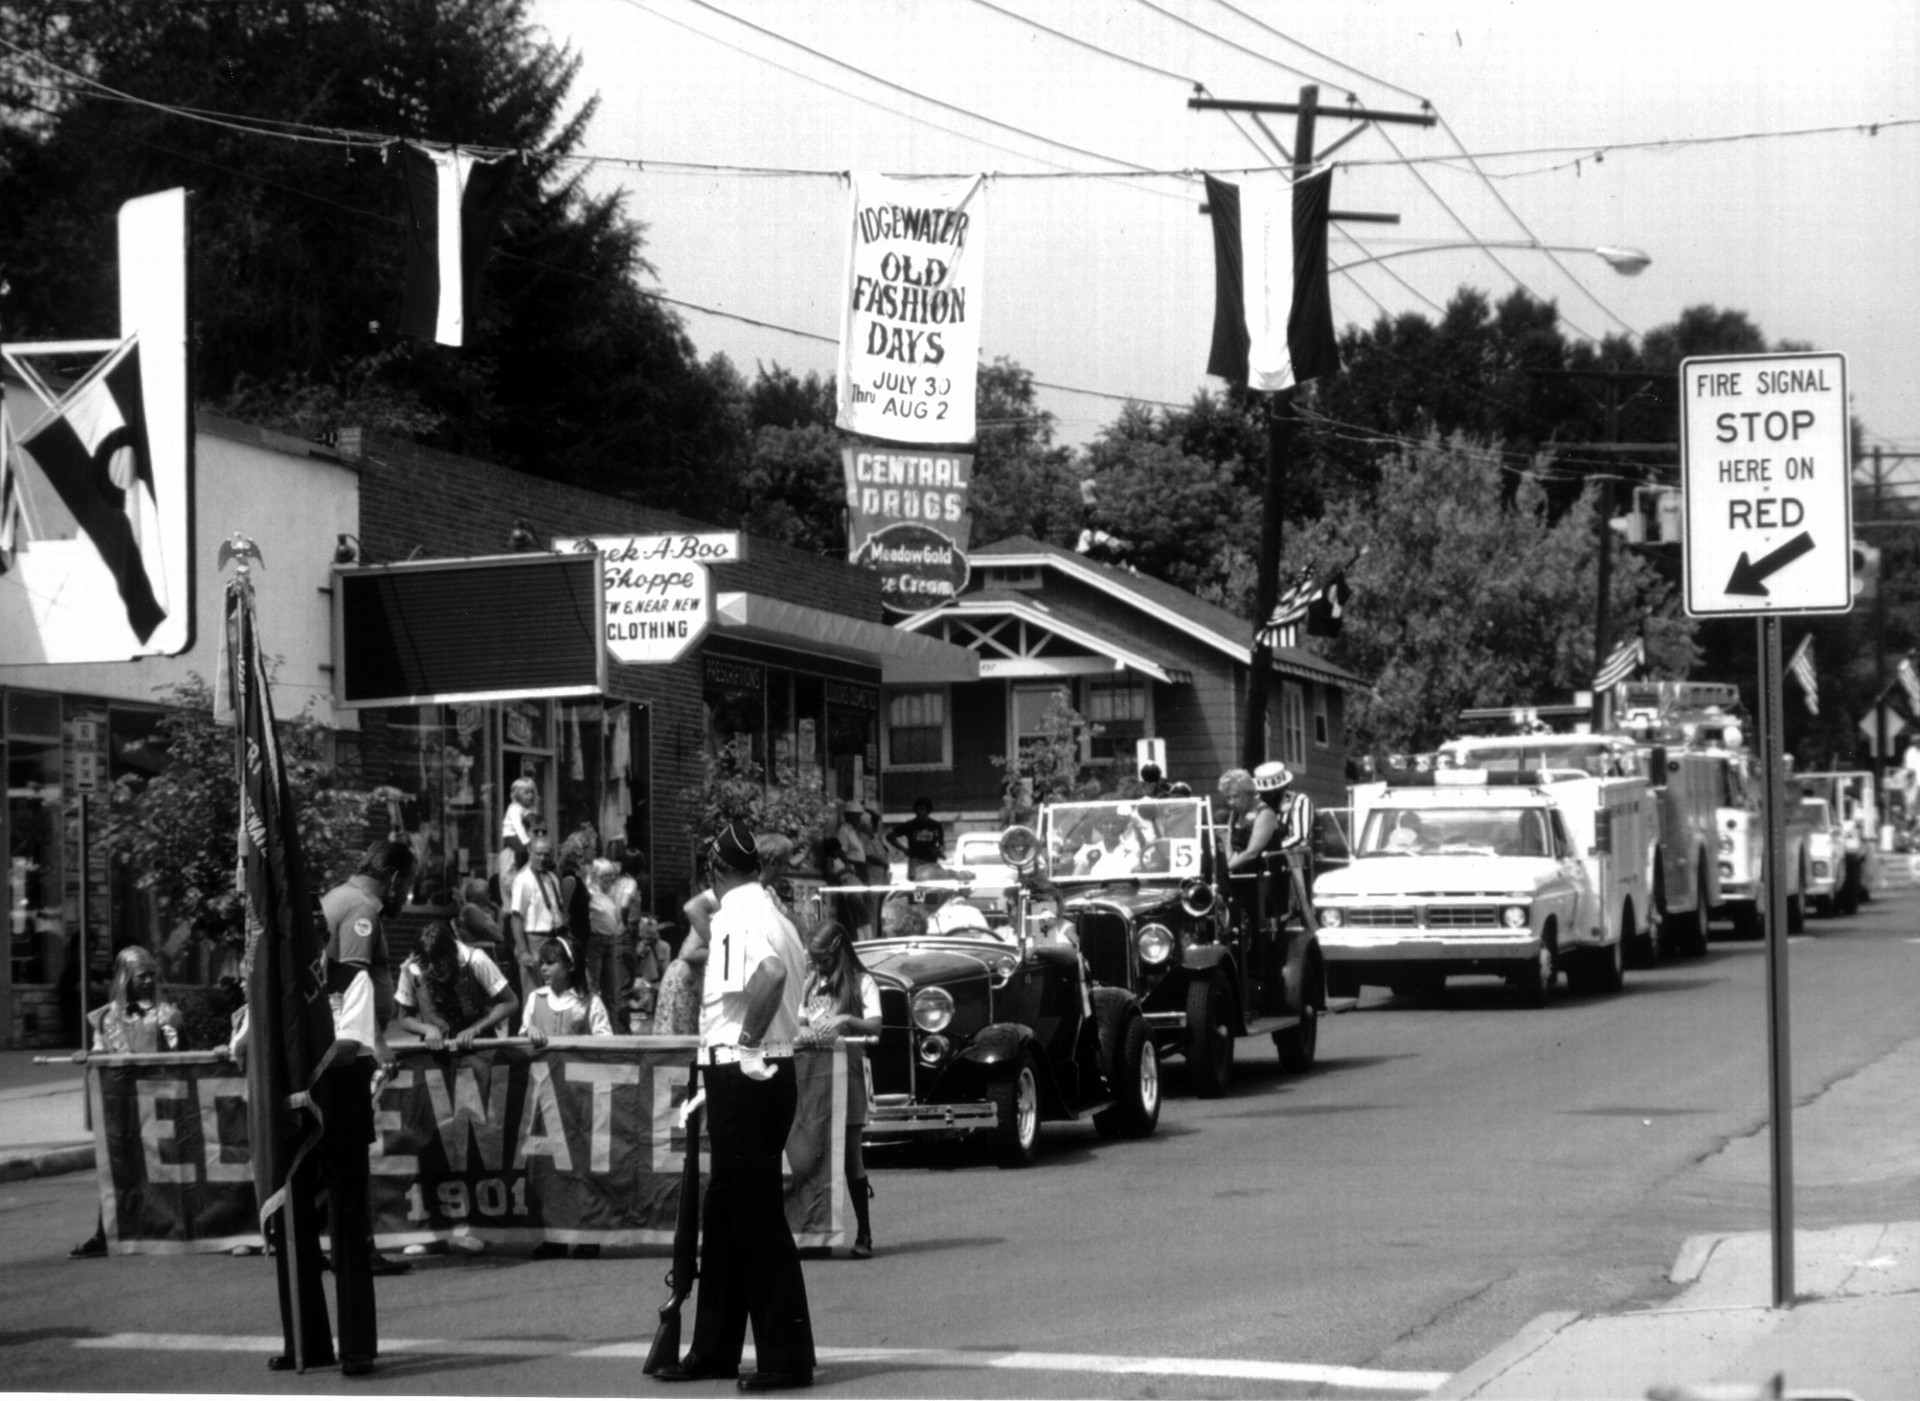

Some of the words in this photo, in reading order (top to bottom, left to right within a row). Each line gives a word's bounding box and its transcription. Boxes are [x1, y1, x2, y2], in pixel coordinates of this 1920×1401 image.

[880, 252, 948, 287] OLD
[852, 274, 966, 324] FASHION
[867, 321, 945, 365] DAYS
[852, 383, 876, 404] Thru
[872, 371, 918, 395] JULY
[924, 377, 951, 397] 30
[1697, 373, 1742, 397] FIRE
[1757, 369, 1832, 395] SIGNAL
[882, 397, 928, 419] AUG
[936, 401, 949, 420] 2
[1716, 410, 1815, 443] STOP
[857, 453, 968, 488] CENTRAL
[1719, 459, 1772, 483] HERE
[1786, 456, 1814, 480] ON
[862, 488, 962, 522] DRUGS
[1729, 498, 1805, 529] RED
[603, 568, 694, 595] Shoppe
[899, 573, 953, 596] Cream
[634, 599, 669, 613] NEAR
[672, 597, 701, 611] NEW
[607, 620, 688, 640] CLOTHING
[1175, 845, 1193, 867] 5
[722, 933, 730, 981] 1
[136, 1060, 793, 1184] EDEWATE
[404, 1177, 529, 1222] 1901
